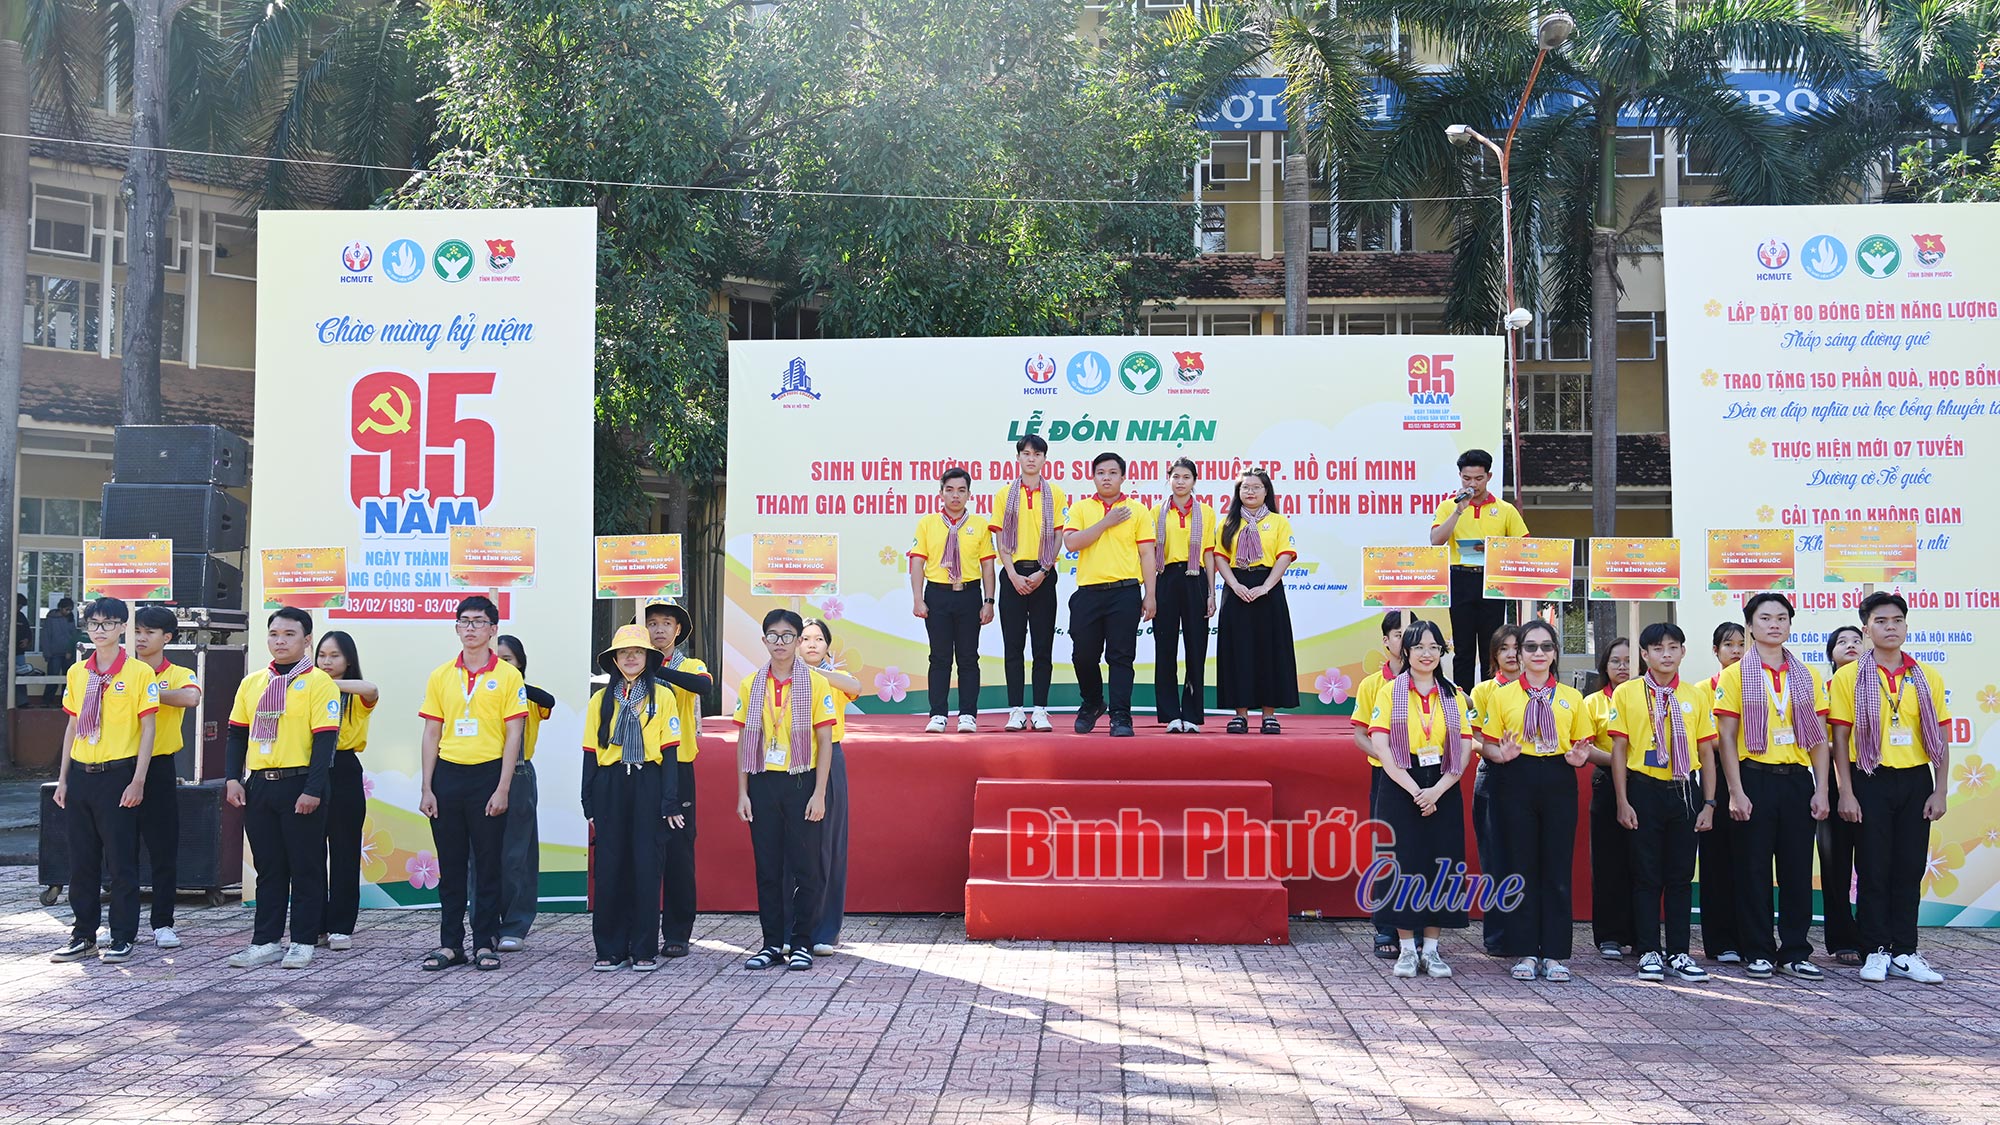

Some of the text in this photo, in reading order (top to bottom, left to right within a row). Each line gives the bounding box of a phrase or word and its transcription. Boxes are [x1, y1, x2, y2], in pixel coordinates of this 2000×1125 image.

[340, 275, 374, 284] HCMUTE
[1756, 272, 1792, 281] HCMUTE
[1728, 300, 1997, 324] LẮP ĐẶT 80 BÓNG ĐÈN NĂNG LƯỢNG
[316, 312, 533, 350] Chào mừng kỷ niệm
[1780, 329, 1821, 352] Thắp
[1825, 333, 1857, 351] sáng
[1408, 354, 1454, 397] 95
[1723, 373, 1761, 389] TRAO
[1766, 370, 1805, 391] TẶNG
[1810, 373, 1836, 388] 150
[1842, 366, 1881, 387] PHẦN
[1888, 368, 1922, 388] QUÀ,
[1929, 371, 1959, 390] HỌC
[1413, 391, 1450, 404] NĂM
[1811, 401, 1849, 422] nghĩa
[1852, 403, 1870, 416] và
[1873, 400, 1896, 419] học
[1900, 397, 1933, 421] bổng
[1936, 398, 1985, 420] khuyến
[1007, 410, 1217, 448] LỄ ĐÓN NHẬN
[350, 371, 496, 512] 95
[1772, 434, 1963, 461] THỰC HIỆN MỚI 07 TUYẾN
[811, 461, 854, 481] SINH
[861, 457, 902, 480] VIÊN
[1294, 453, 1320, 480] HỒ
[1326, 456, 1358, 480] CHÍ
[1365, 460, 1416, 480] MINH
[365, 493, 478, 534] NĂM
[756, 494, 808, 514] THAM
[816, 494, 846, 514] GIA
[853, 487, 907, 514] CHIẾN
[1275, 494, 1301, 518] TẠI
[1308, 488, 1350, 514] TỈNH
[1358, 490, 1402, 514] BÌNH
[1781, 504, 1806, 524] CẢI
[1867, 505, 1919, 522] KHÔNG
[1925, 507, 1961, 524] GIAN
[1927, 533, 1950, 550] nhi
[365, 549, 448, 566] NGÀY THÀNH
[374, 570, 410, 590] CỘNG
[415, 569, 441, 587] SẢN
[346, 598, 415, 613] 03/02/1930
[1803, 592, 1837, 612] LỊCH
[1908, 589, 1939, 608] HÓA
[1944, 592, 1960, 608] DI
[1965, 588, 2000, 608] TÍCH
[1801, 630, 1819, 643] CÁC
[1915, 631, 1926, 642] XÃ
[1929, 631, 1945, 644] HỘI
[1948, 631, 1972, 642] KHÁC
[1802, 650, 1945, 662] TRÊN PHƯỚC
